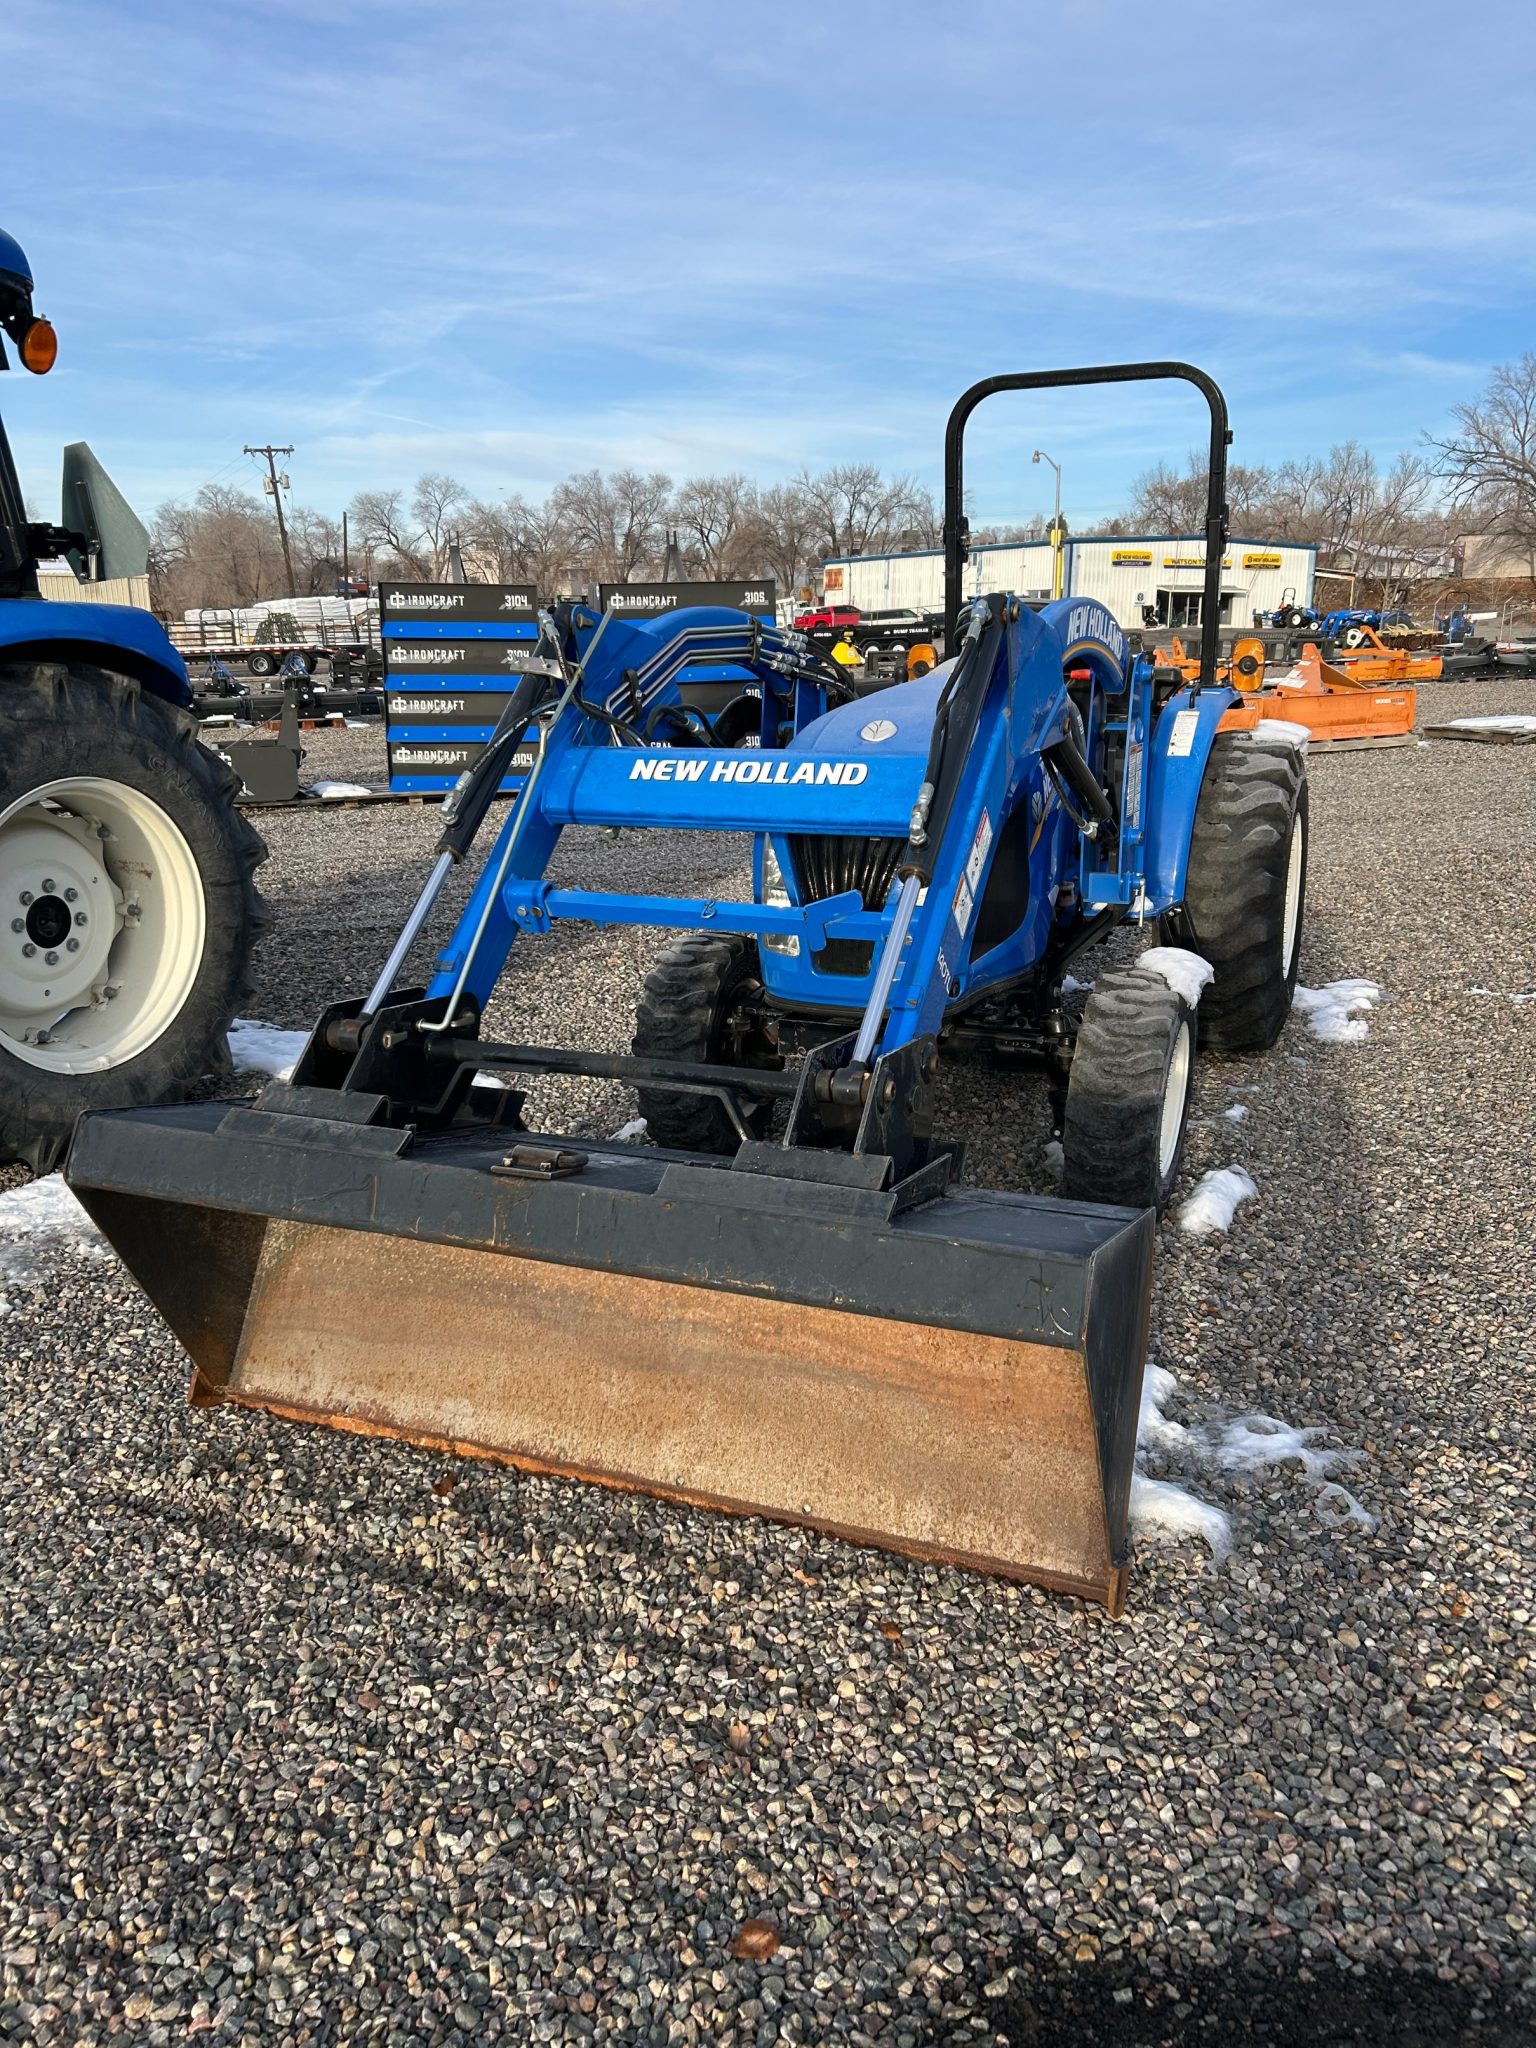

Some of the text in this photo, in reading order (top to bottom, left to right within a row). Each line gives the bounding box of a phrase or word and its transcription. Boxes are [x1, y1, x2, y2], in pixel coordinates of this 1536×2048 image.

[407, 594, 528, 607] IRONCRAFT 3104
[626, 595, 678, 607] IRONCRAFT
[1067, 605, 1122, 661] NEW HOLLAND
[409, 648, 466, 661] IRONCRAFT
[409, 699, 465, 711] IRONCRAFT
[745, 736, 761, 747] 310
[413, 750, 468, 762] IRONCRAFT
[629, 758, 869, 786] NEW HOLLAND
